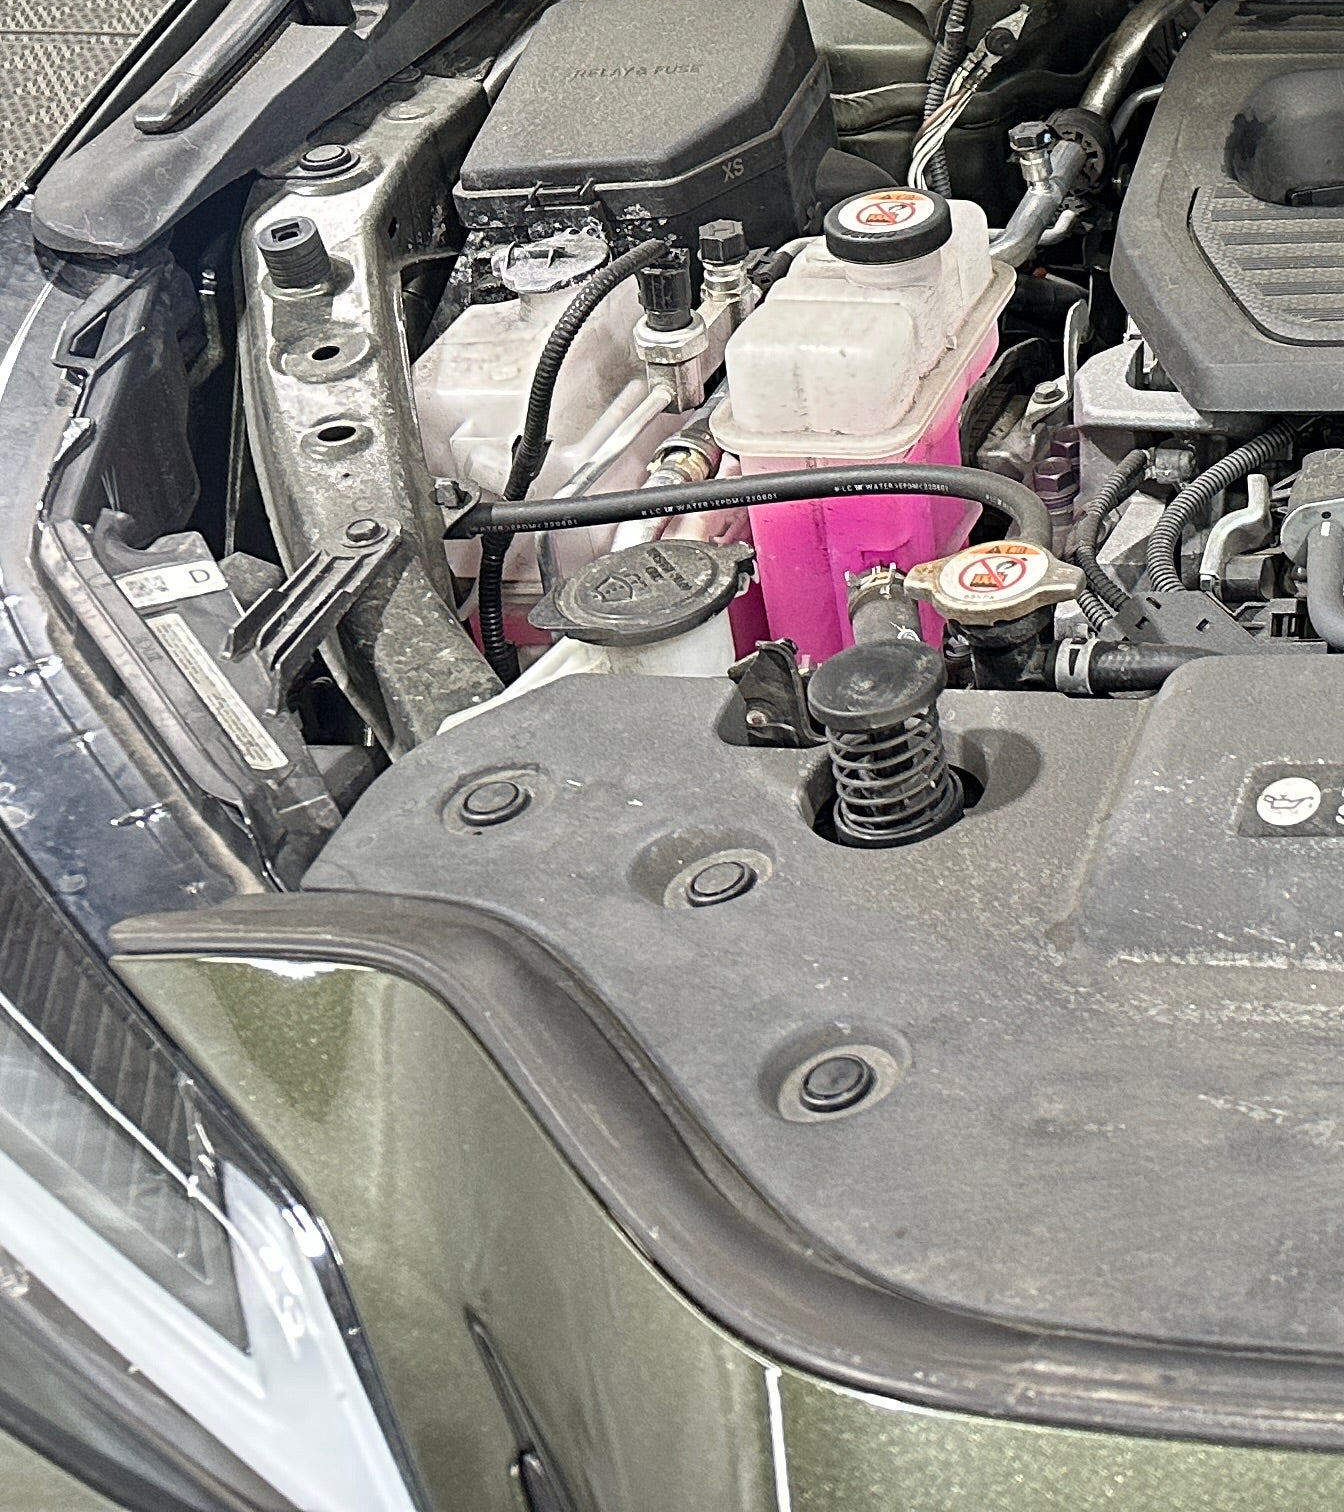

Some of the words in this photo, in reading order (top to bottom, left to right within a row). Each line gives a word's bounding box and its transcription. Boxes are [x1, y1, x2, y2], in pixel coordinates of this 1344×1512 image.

[572, 66, 635, 79] RELAY
[653, 63, 701, 76] FUSE
[721, 157, 745, 183] XS
[677, 501, 710, 512] WATER
[189, 568, 211, 584] D
